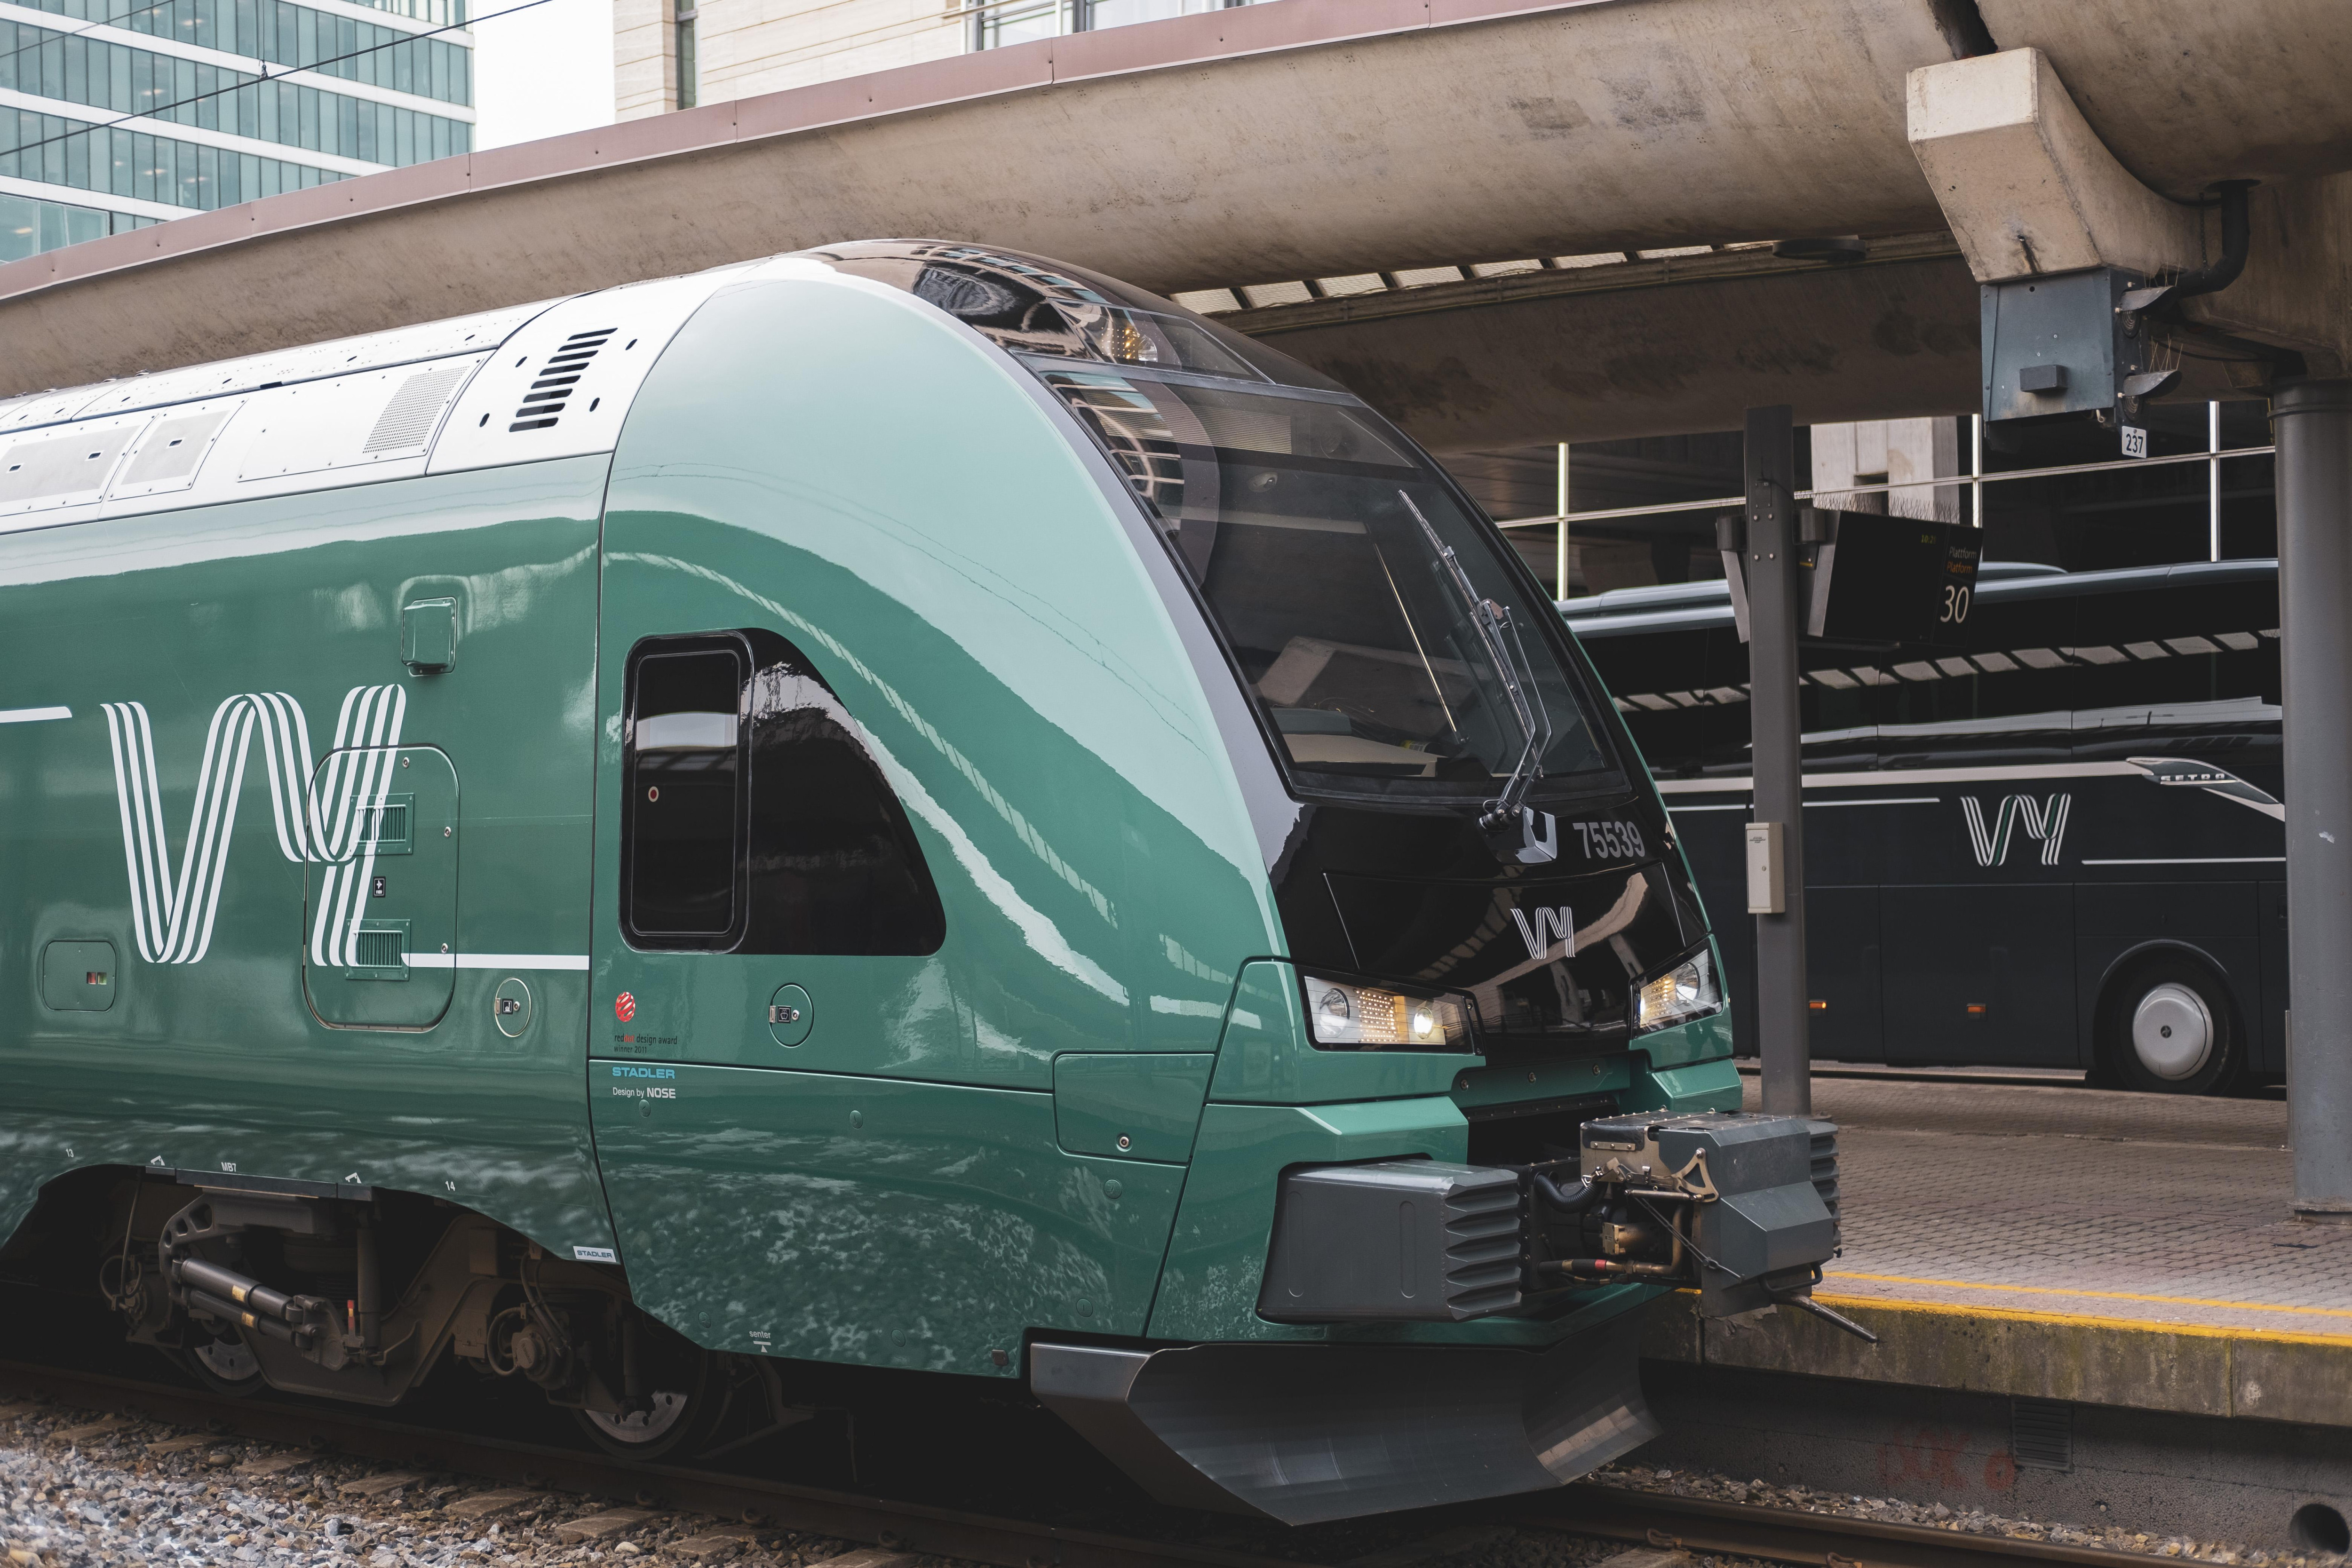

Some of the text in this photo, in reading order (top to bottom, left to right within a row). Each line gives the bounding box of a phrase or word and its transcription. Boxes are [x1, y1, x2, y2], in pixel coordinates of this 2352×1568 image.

[2126, 433, 2144, 454] 237
[1949, 546, 1977, 560] Plattform
[1947, 561, 1973, 574] Platform
[1940, 585, 1970, 624] 30
[1573, 821, 1645, 859] 75539
[636, 1034, 656, 1045] design
[659, 1036, 677, 1044] award
[612, 1067, 675, 1079] STADLER
[612, 1087, 676, 1098] Design by NOSE
[65, 1148, 74, 1158] 13
[221, 1162, 236, 1172] MB7
[445, 1180, 455, 1191] 14
